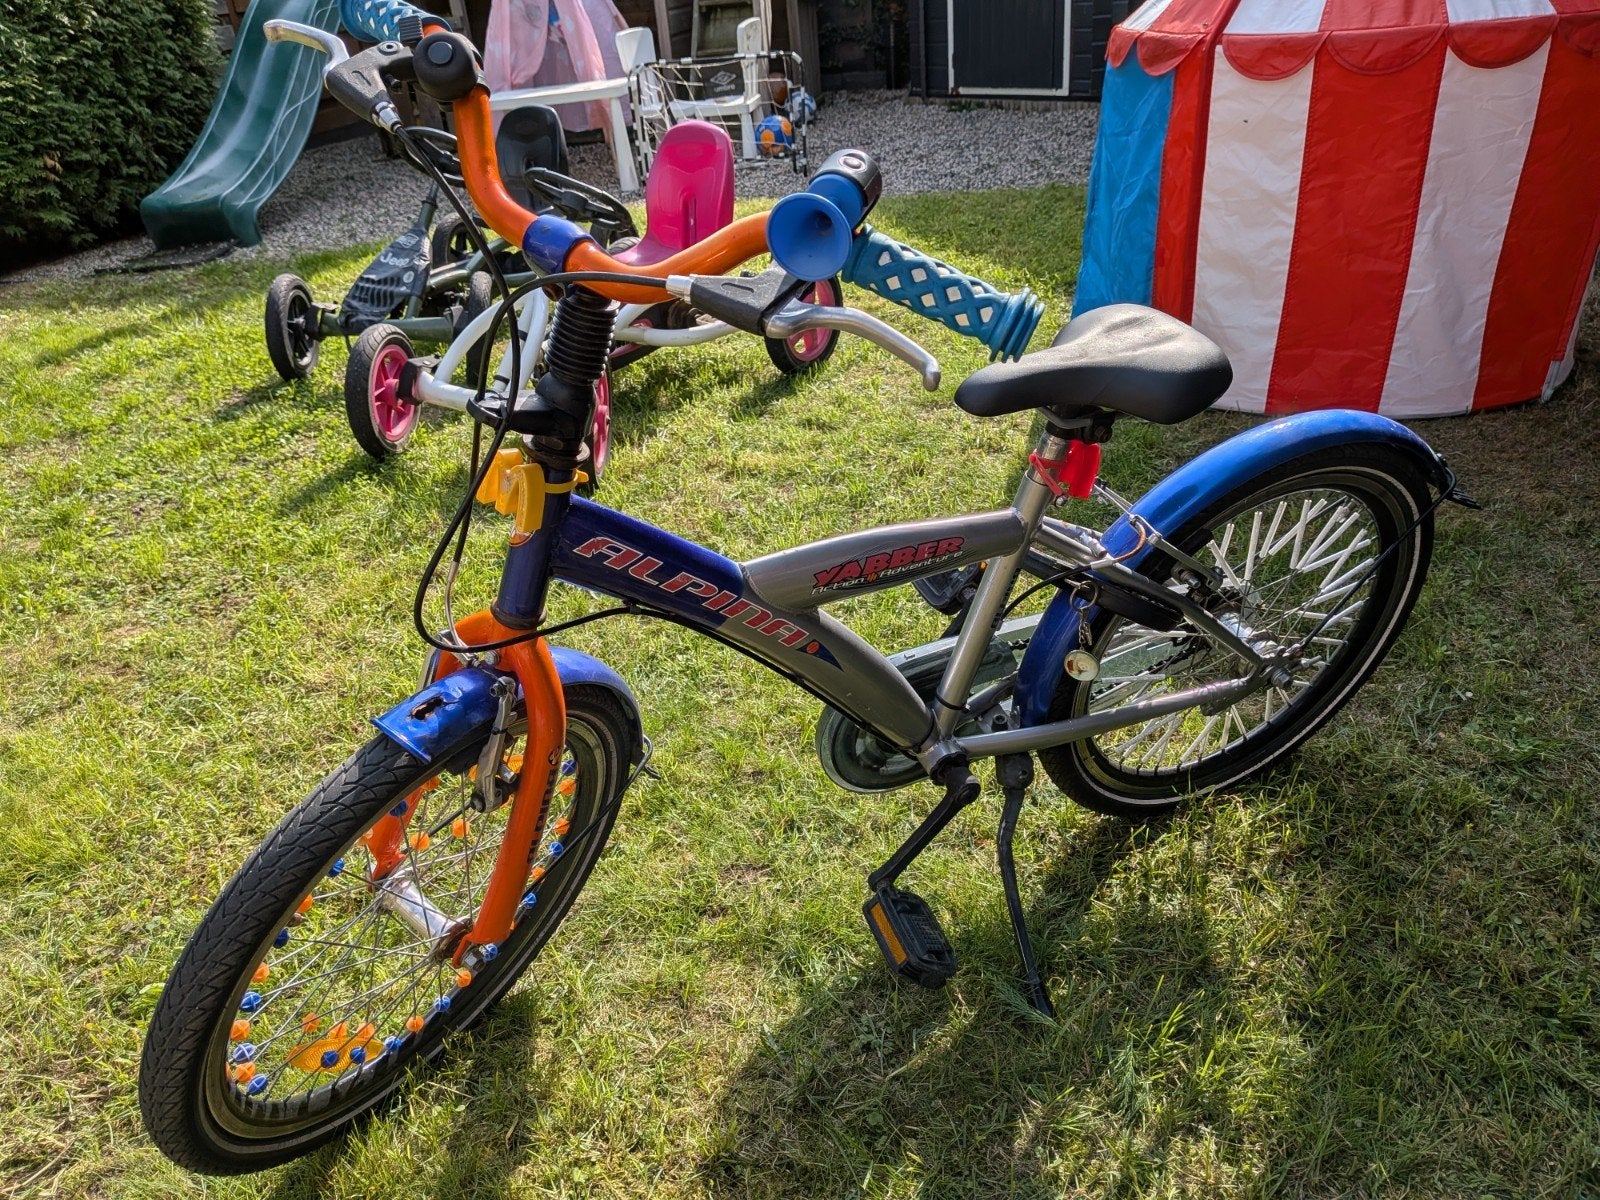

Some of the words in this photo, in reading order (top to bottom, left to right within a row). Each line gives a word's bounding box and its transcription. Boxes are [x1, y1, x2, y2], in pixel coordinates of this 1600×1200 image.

[380, 252, 410, 267] Jeep
[811, 577, 865, 595] Action
[878, 550, 964, 578] Adventure
[813, 536, 965, 588] YABBER
[573, 536, 810, 648] ALPINA
